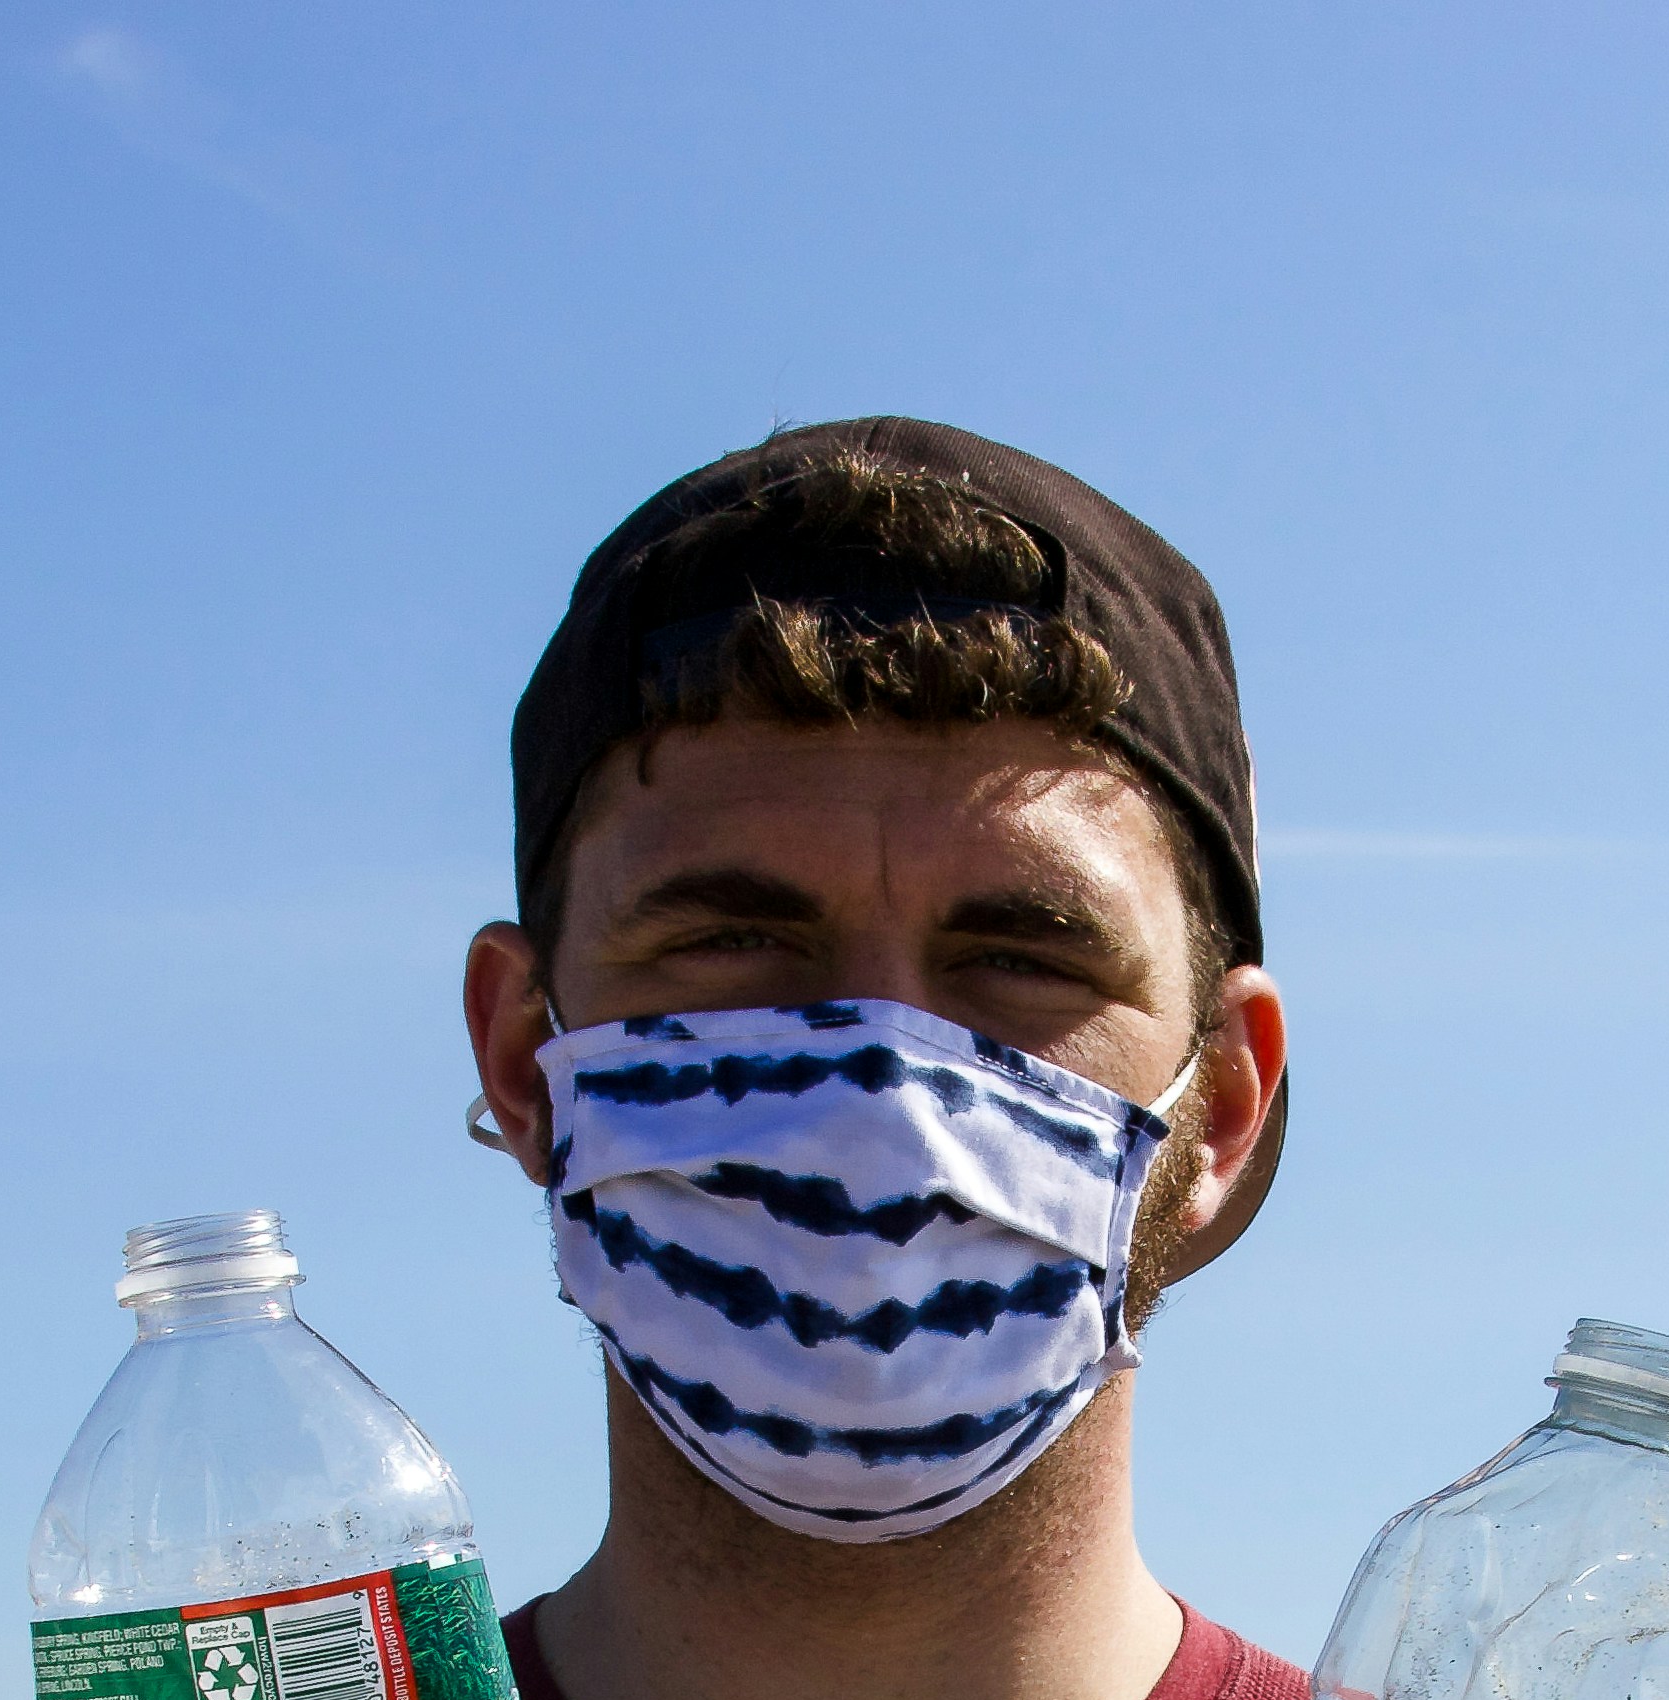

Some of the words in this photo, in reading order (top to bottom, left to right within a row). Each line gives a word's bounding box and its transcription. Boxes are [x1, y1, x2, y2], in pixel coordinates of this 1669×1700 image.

[375, 1586, 393, 1624] STATES
[151, 1622, 180, 1636] CEDAR
[200, 1624, 229, 1635] Empty
[231, 1622, 239, 1630] &
[192, 1634, 228, 1645] Replace
[231, 1630, 250, 1641] Cap
[381, 1624, 403, 1666] DEPOSIT
[130, 1655, 164, 1670] POLAND
[356, 1627, 381, 1684] 48127
